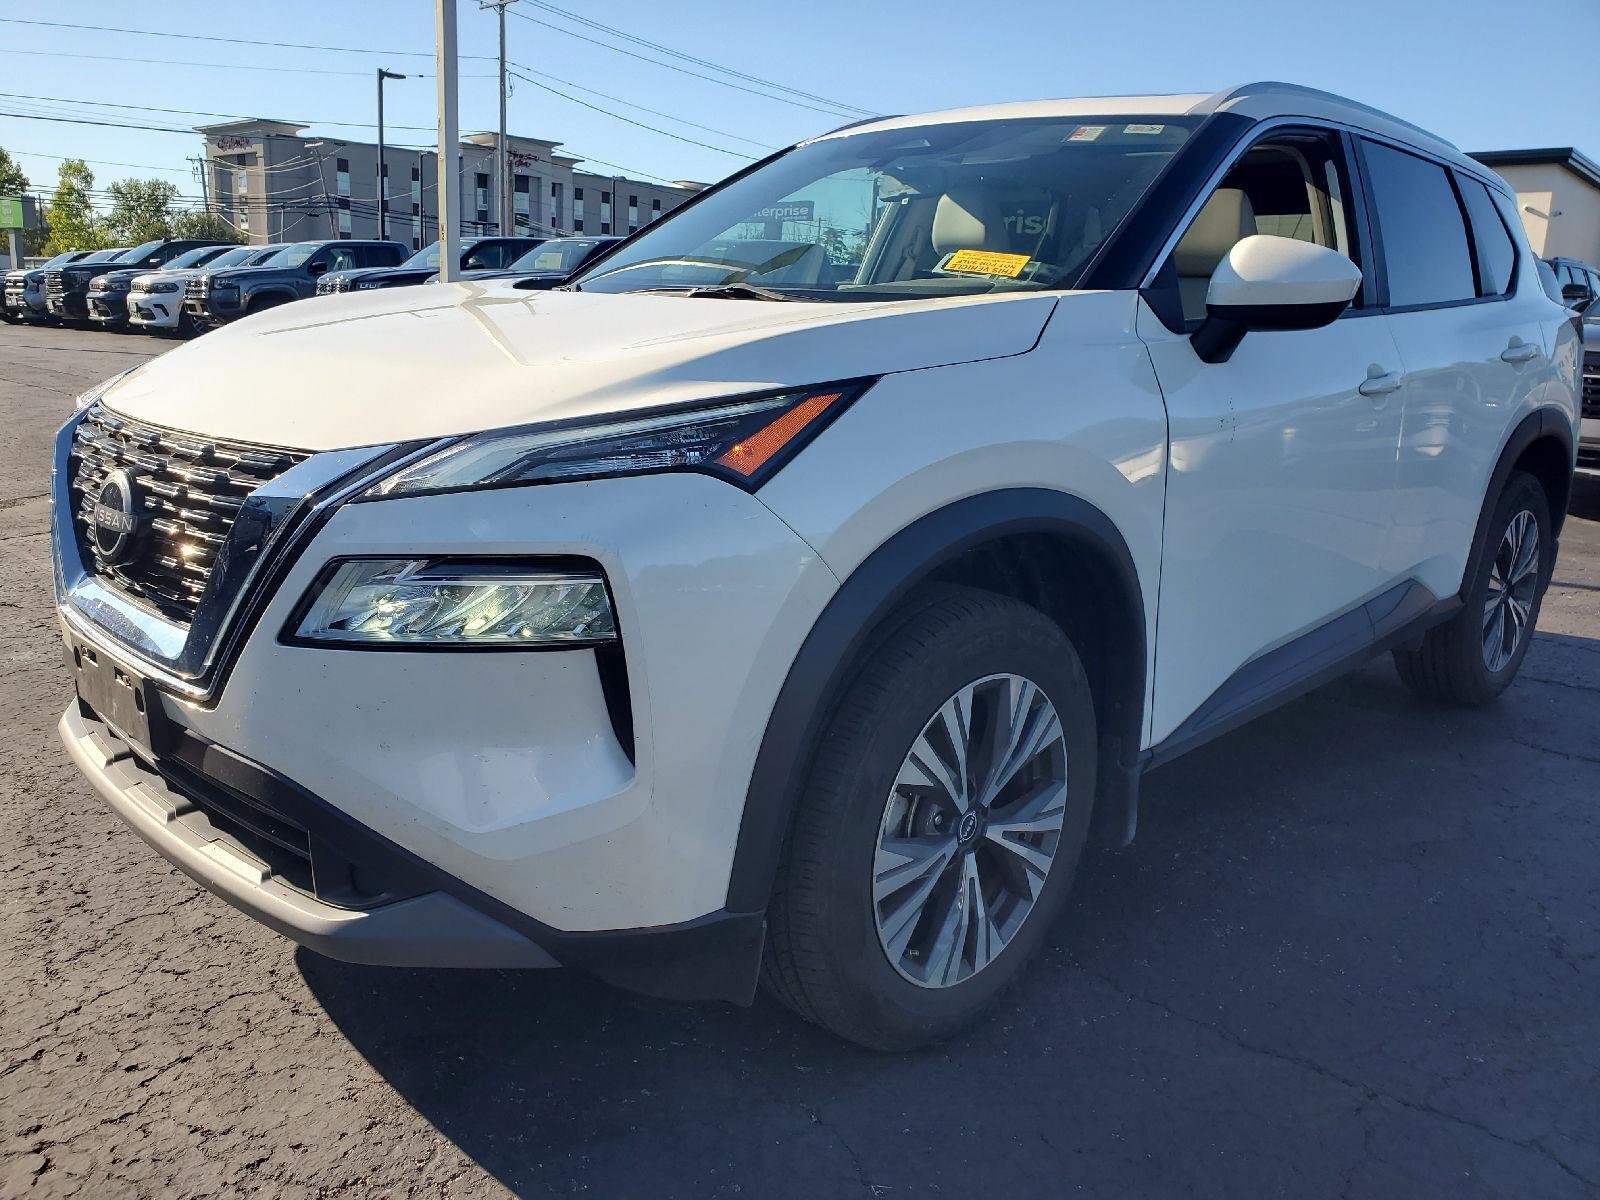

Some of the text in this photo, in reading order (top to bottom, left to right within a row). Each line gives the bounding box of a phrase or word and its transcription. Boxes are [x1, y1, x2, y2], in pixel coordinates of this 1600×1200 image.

[754, 205, 809, 219] erprise
[949, 263, 1015, 275] THIS VEHICLE
